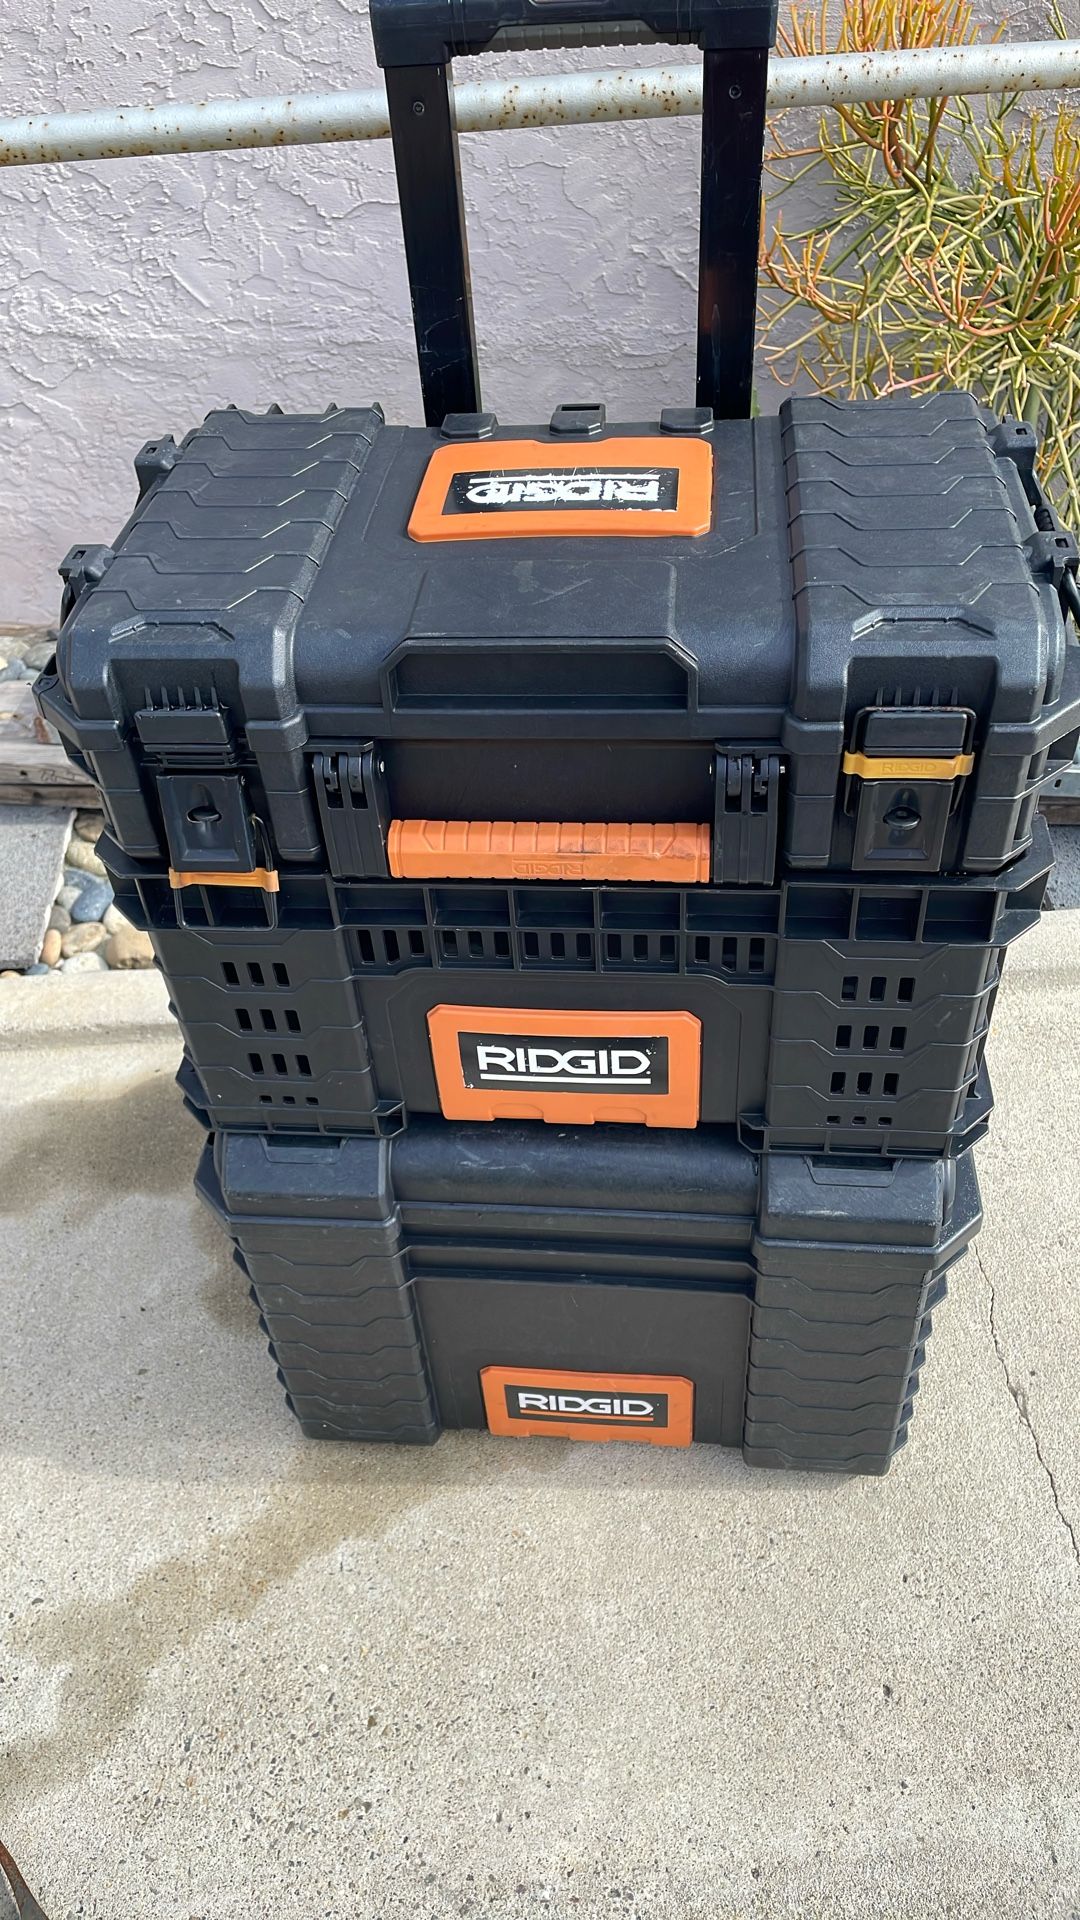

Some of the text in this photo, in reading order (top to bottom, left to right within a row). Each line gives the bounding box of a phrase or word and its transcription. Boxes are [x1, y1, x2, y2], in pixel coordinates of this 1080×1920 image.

[881, 762, 937, 773] RIDGID
[512, 863, 583, 876] RIDGID
[476, 1045, 651, 1075] RIDGID
[518, 1392, 654, 1416] RIDGID
